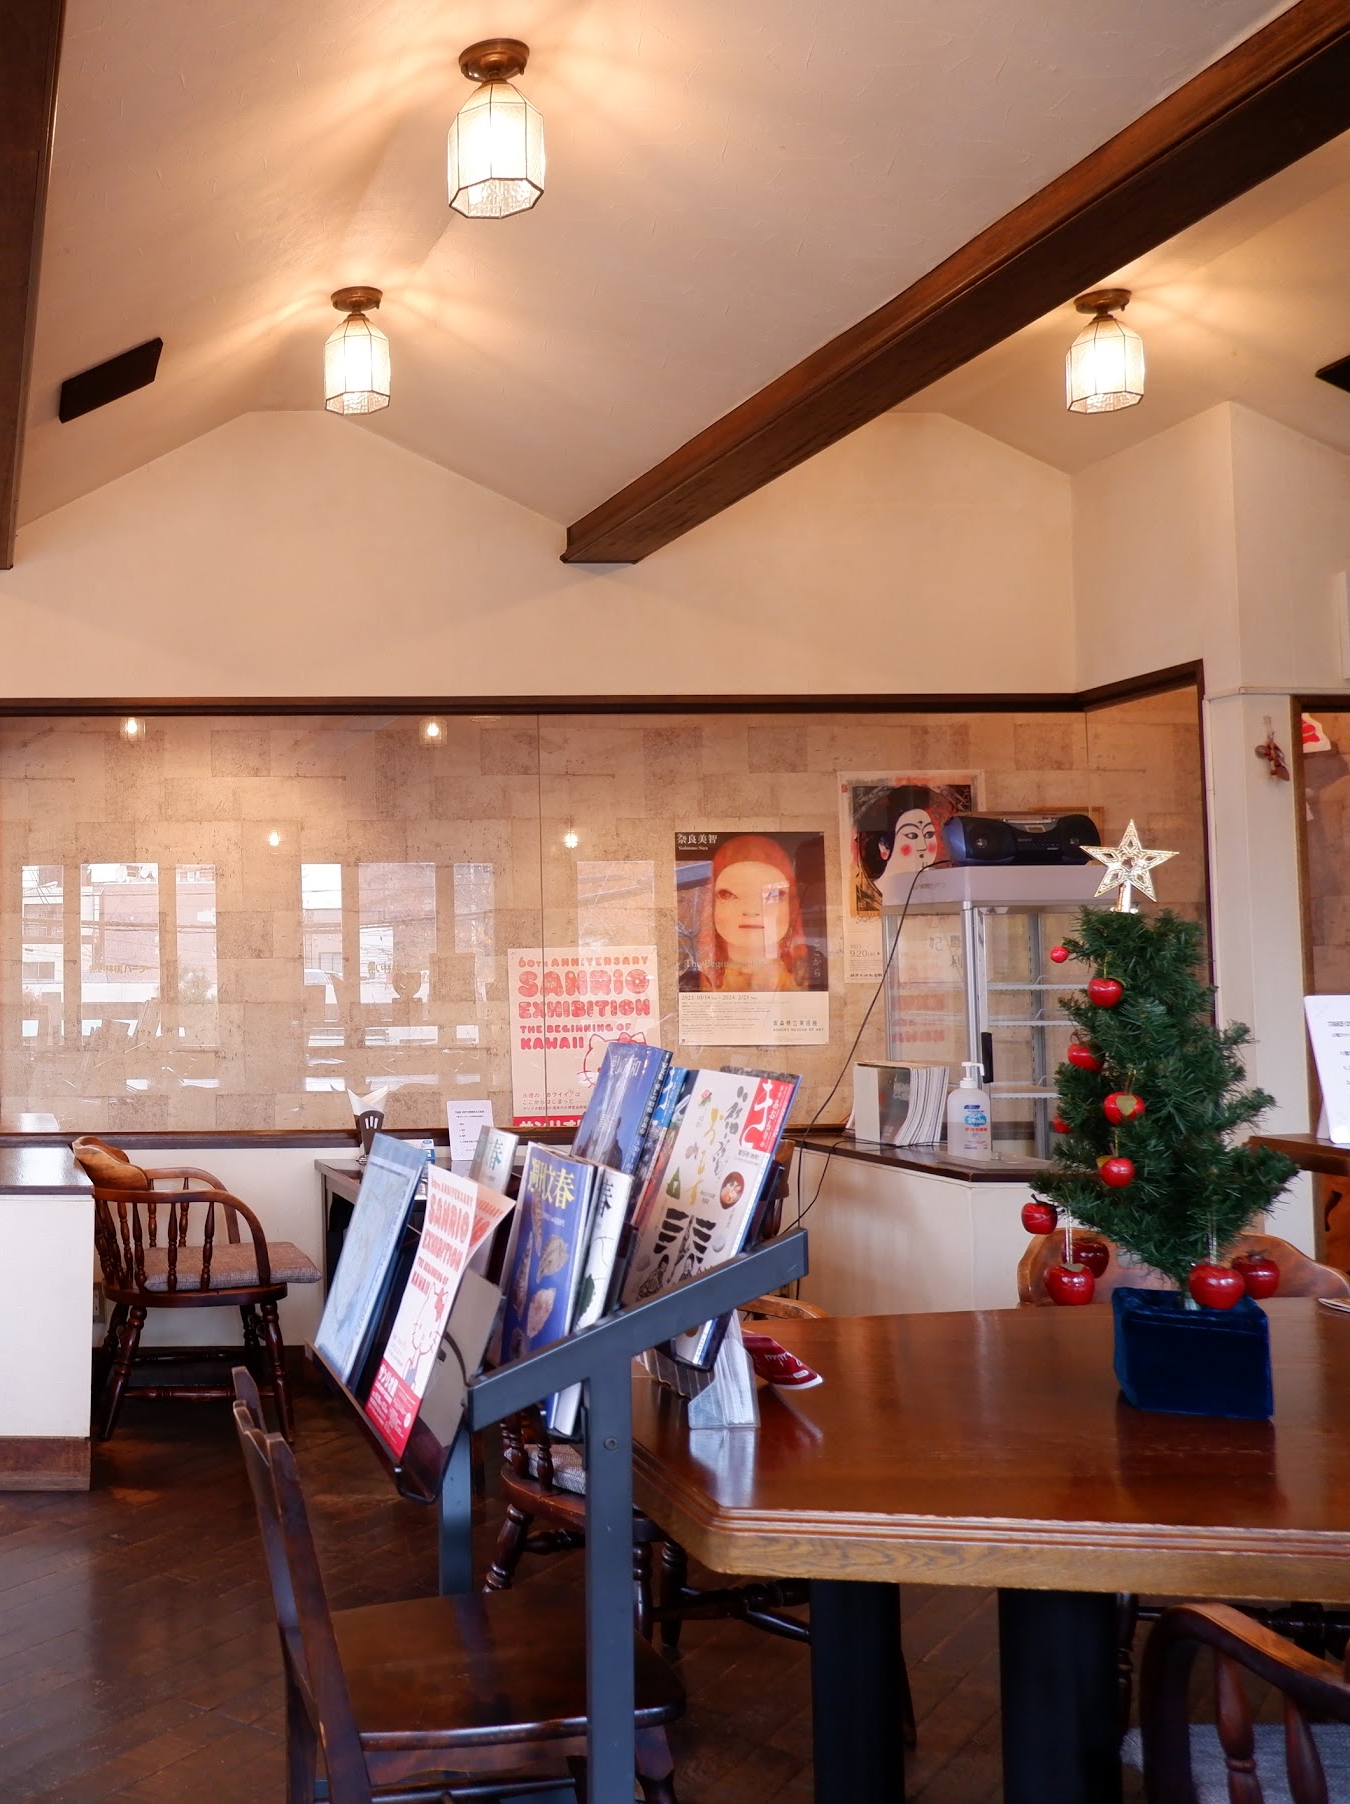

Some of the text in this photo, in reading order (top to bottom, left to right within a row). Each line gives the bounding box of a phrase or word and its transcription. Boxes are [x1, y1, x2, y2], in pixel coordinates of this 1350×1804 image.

[677, 834, 718, 844] 奈良美智
[518, 956, 649, 968] 60TH ANNIVERSARY
[517, 968, 650, 998] SANRIO
[518, 998, 651, 1019] EXHIBITION
[520, 1023, 632, 1034] THE BEGINNING OF
[520, 1036, 584, 1050] KAWAII
[428, 1193, 470, 1244] SANRIO
[422, 1230, 463, 1272] EXHIBITION
[411, 1270, 430, 1296] KAWAII
